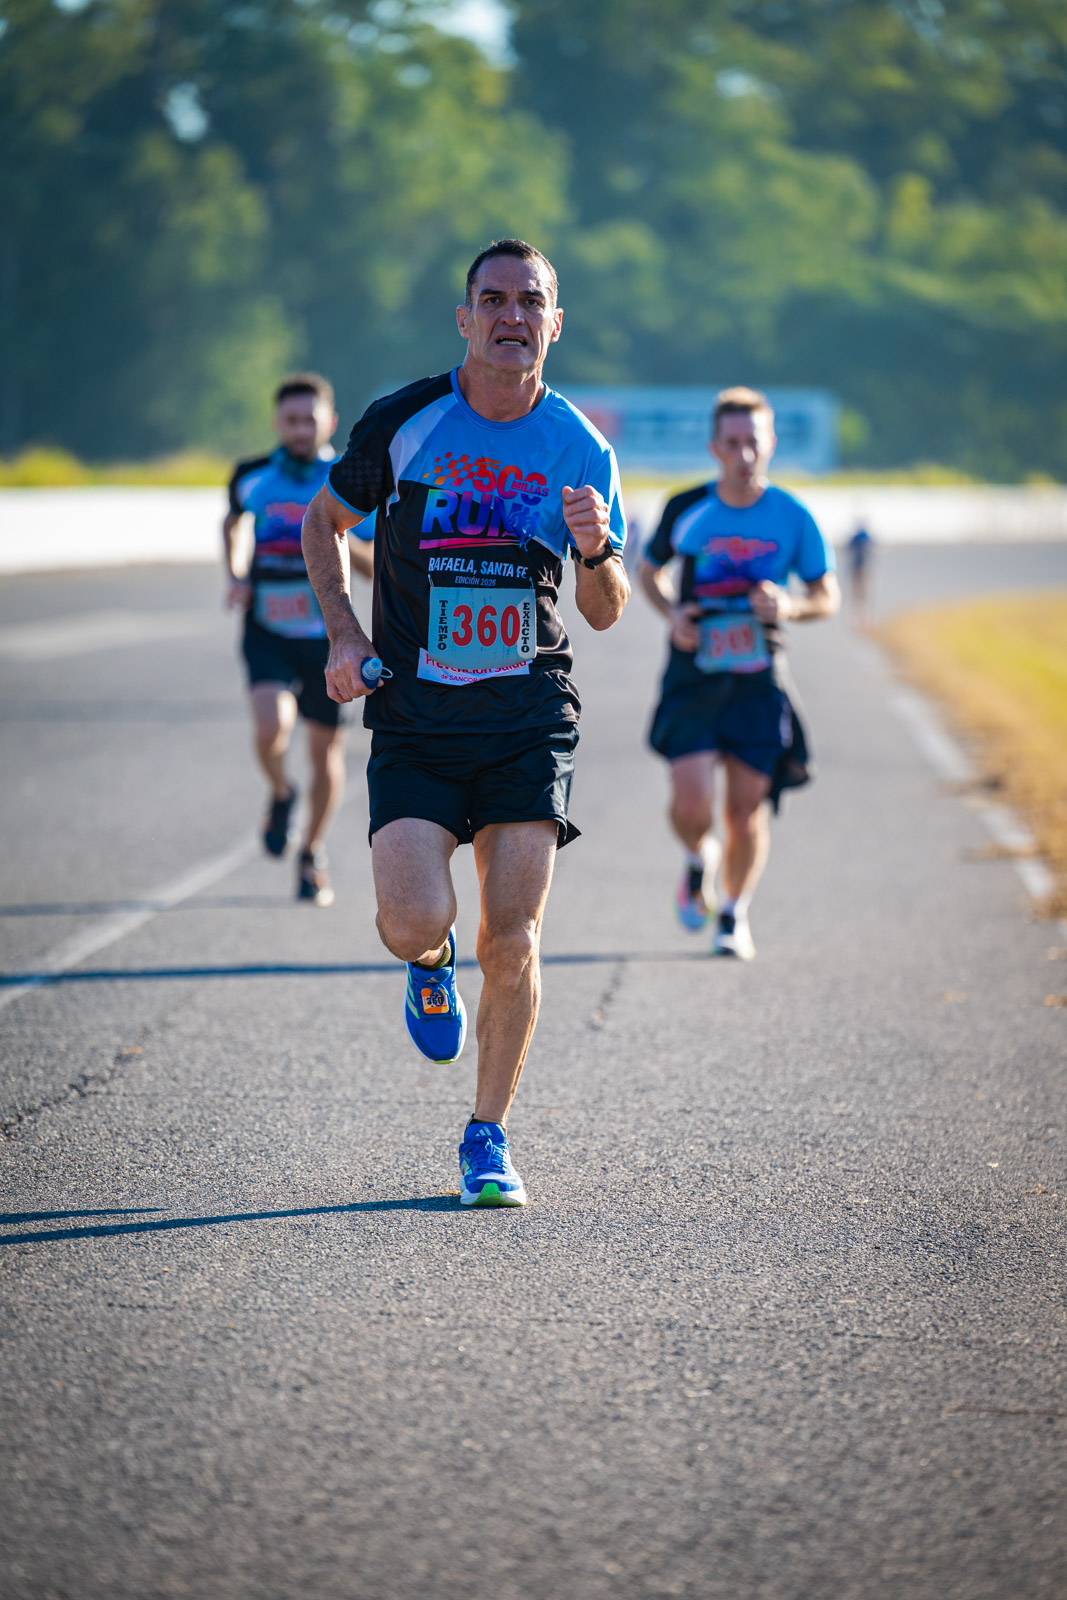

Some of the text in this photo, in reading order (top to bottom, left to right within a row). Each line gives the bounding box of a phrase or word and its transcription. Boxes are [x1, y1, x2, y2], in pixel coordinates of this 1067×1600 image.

[473, 457, 547, 506] 500
[510, 480, 550, 497] MILLAS
[421, 489, 524, 537] RUN
[428, 557, 529, 579] RAFAELA, SANTA FE
[454, 575, 480, 585] EDICIÓN
[437, 599, 449, 651] TIEMPO
[451, 603, 521, 648] 360
[520, 602, 531, 653] EXACTO
